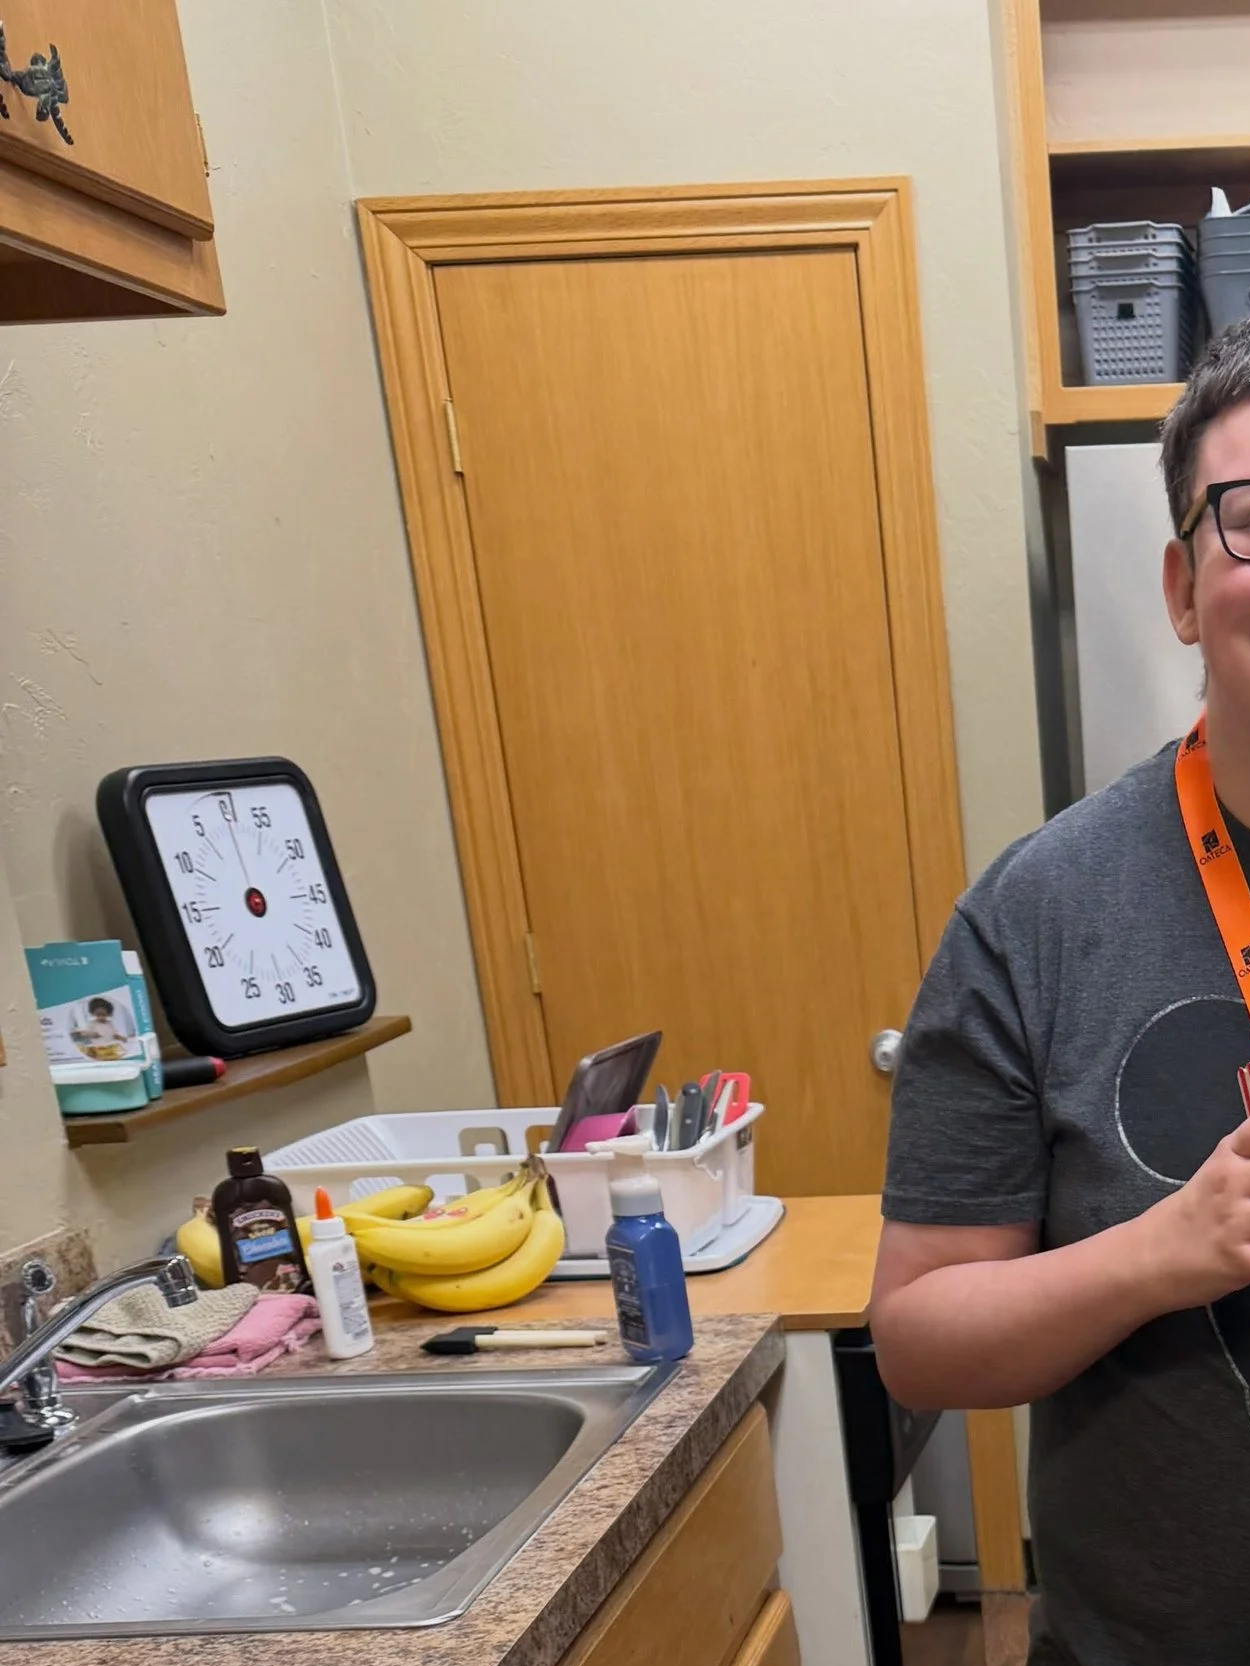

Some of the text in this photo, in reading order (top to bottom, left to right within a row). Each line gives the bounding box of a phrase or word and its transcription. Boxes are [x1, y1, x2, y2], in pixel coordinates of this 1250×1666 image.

[192, 815, 205, 837] 5
[250, 806, 271, 828] 55
[285, 838, 304, 860] 50
[175, 851, 194, 874] 10
[309, 883, 327, 905] 45
[182, 902, 202, 923] 15
[314, 928, 332, 950] 40
[205, 946, 224, 968] 20
[303, 966, 323, 987] 35
[241, 977, 261, 999] 25
[275, 982, 295, 1004] 30
